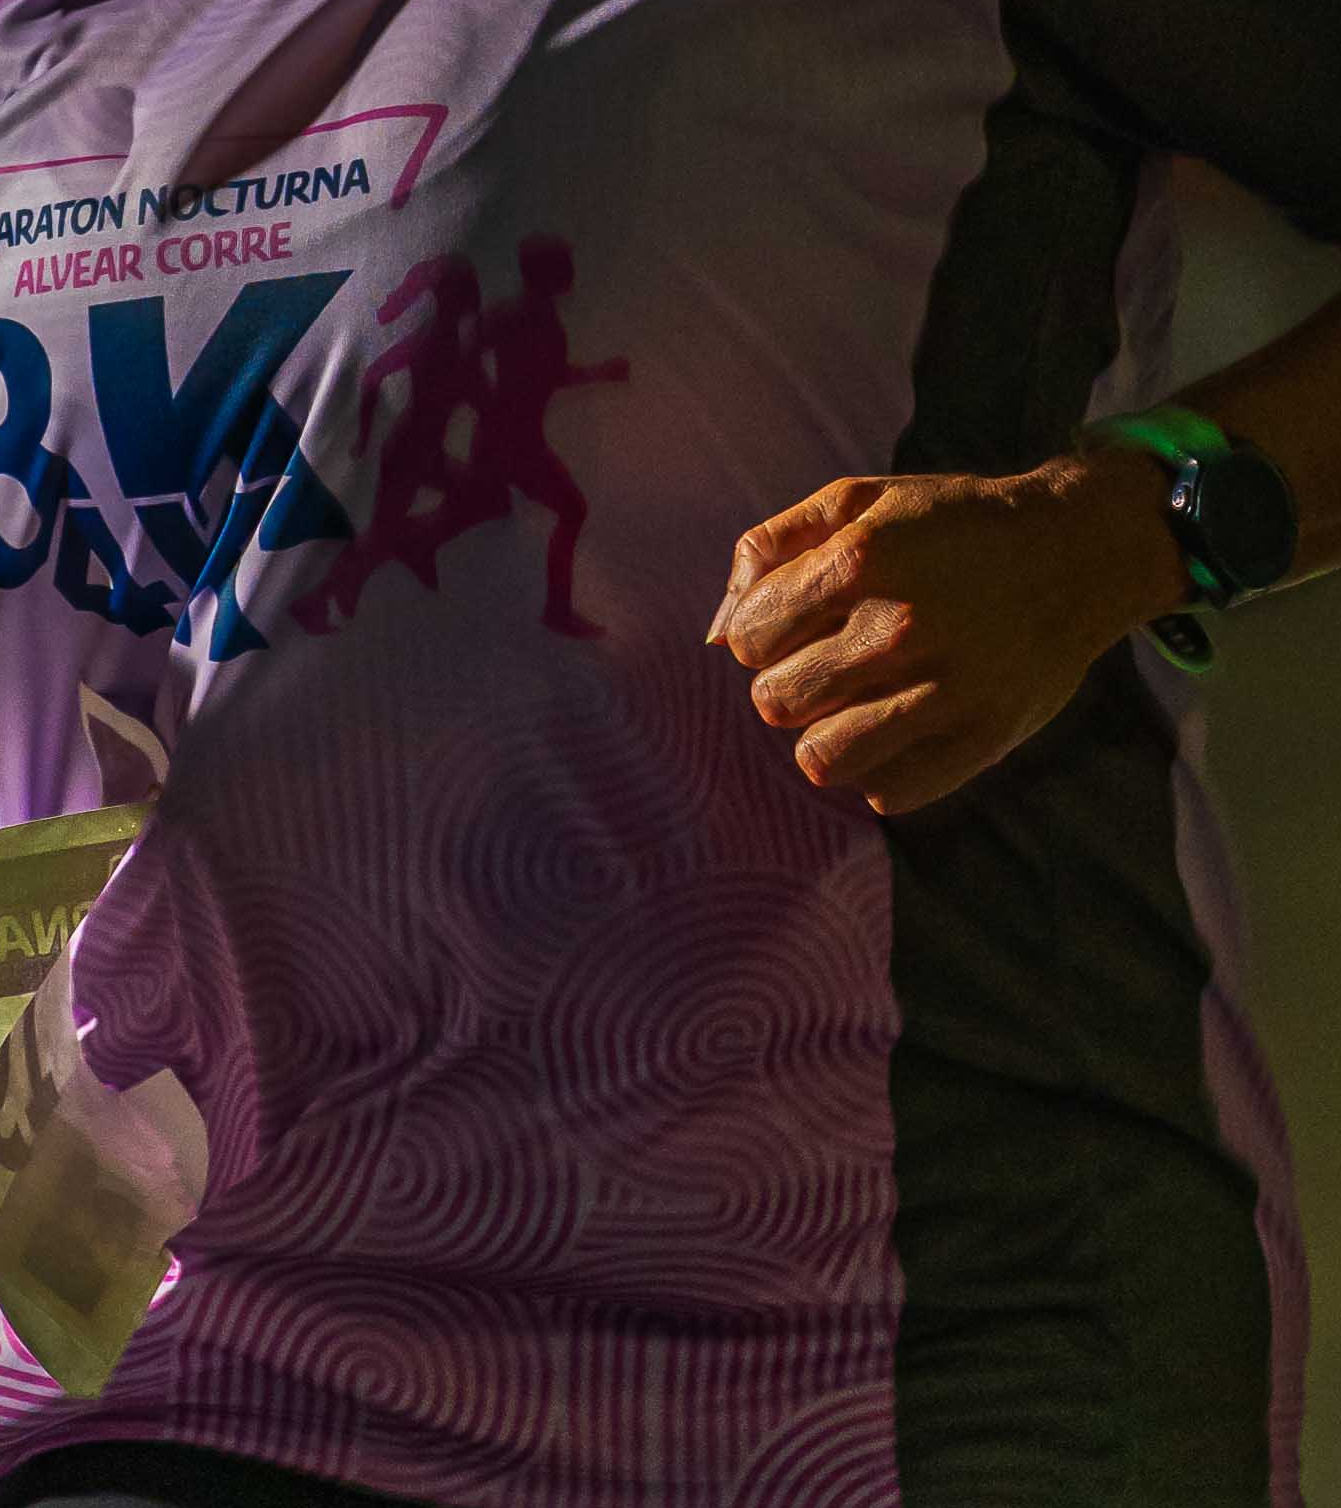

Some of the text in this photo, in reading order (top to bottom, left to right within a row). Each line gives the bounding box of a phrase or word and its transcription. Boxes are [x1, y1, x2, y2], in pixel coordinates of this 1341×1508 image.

[138, 157, 371, 227] NOCTURNA
[13, 220, 293, 298] ALVEAR CORRE
